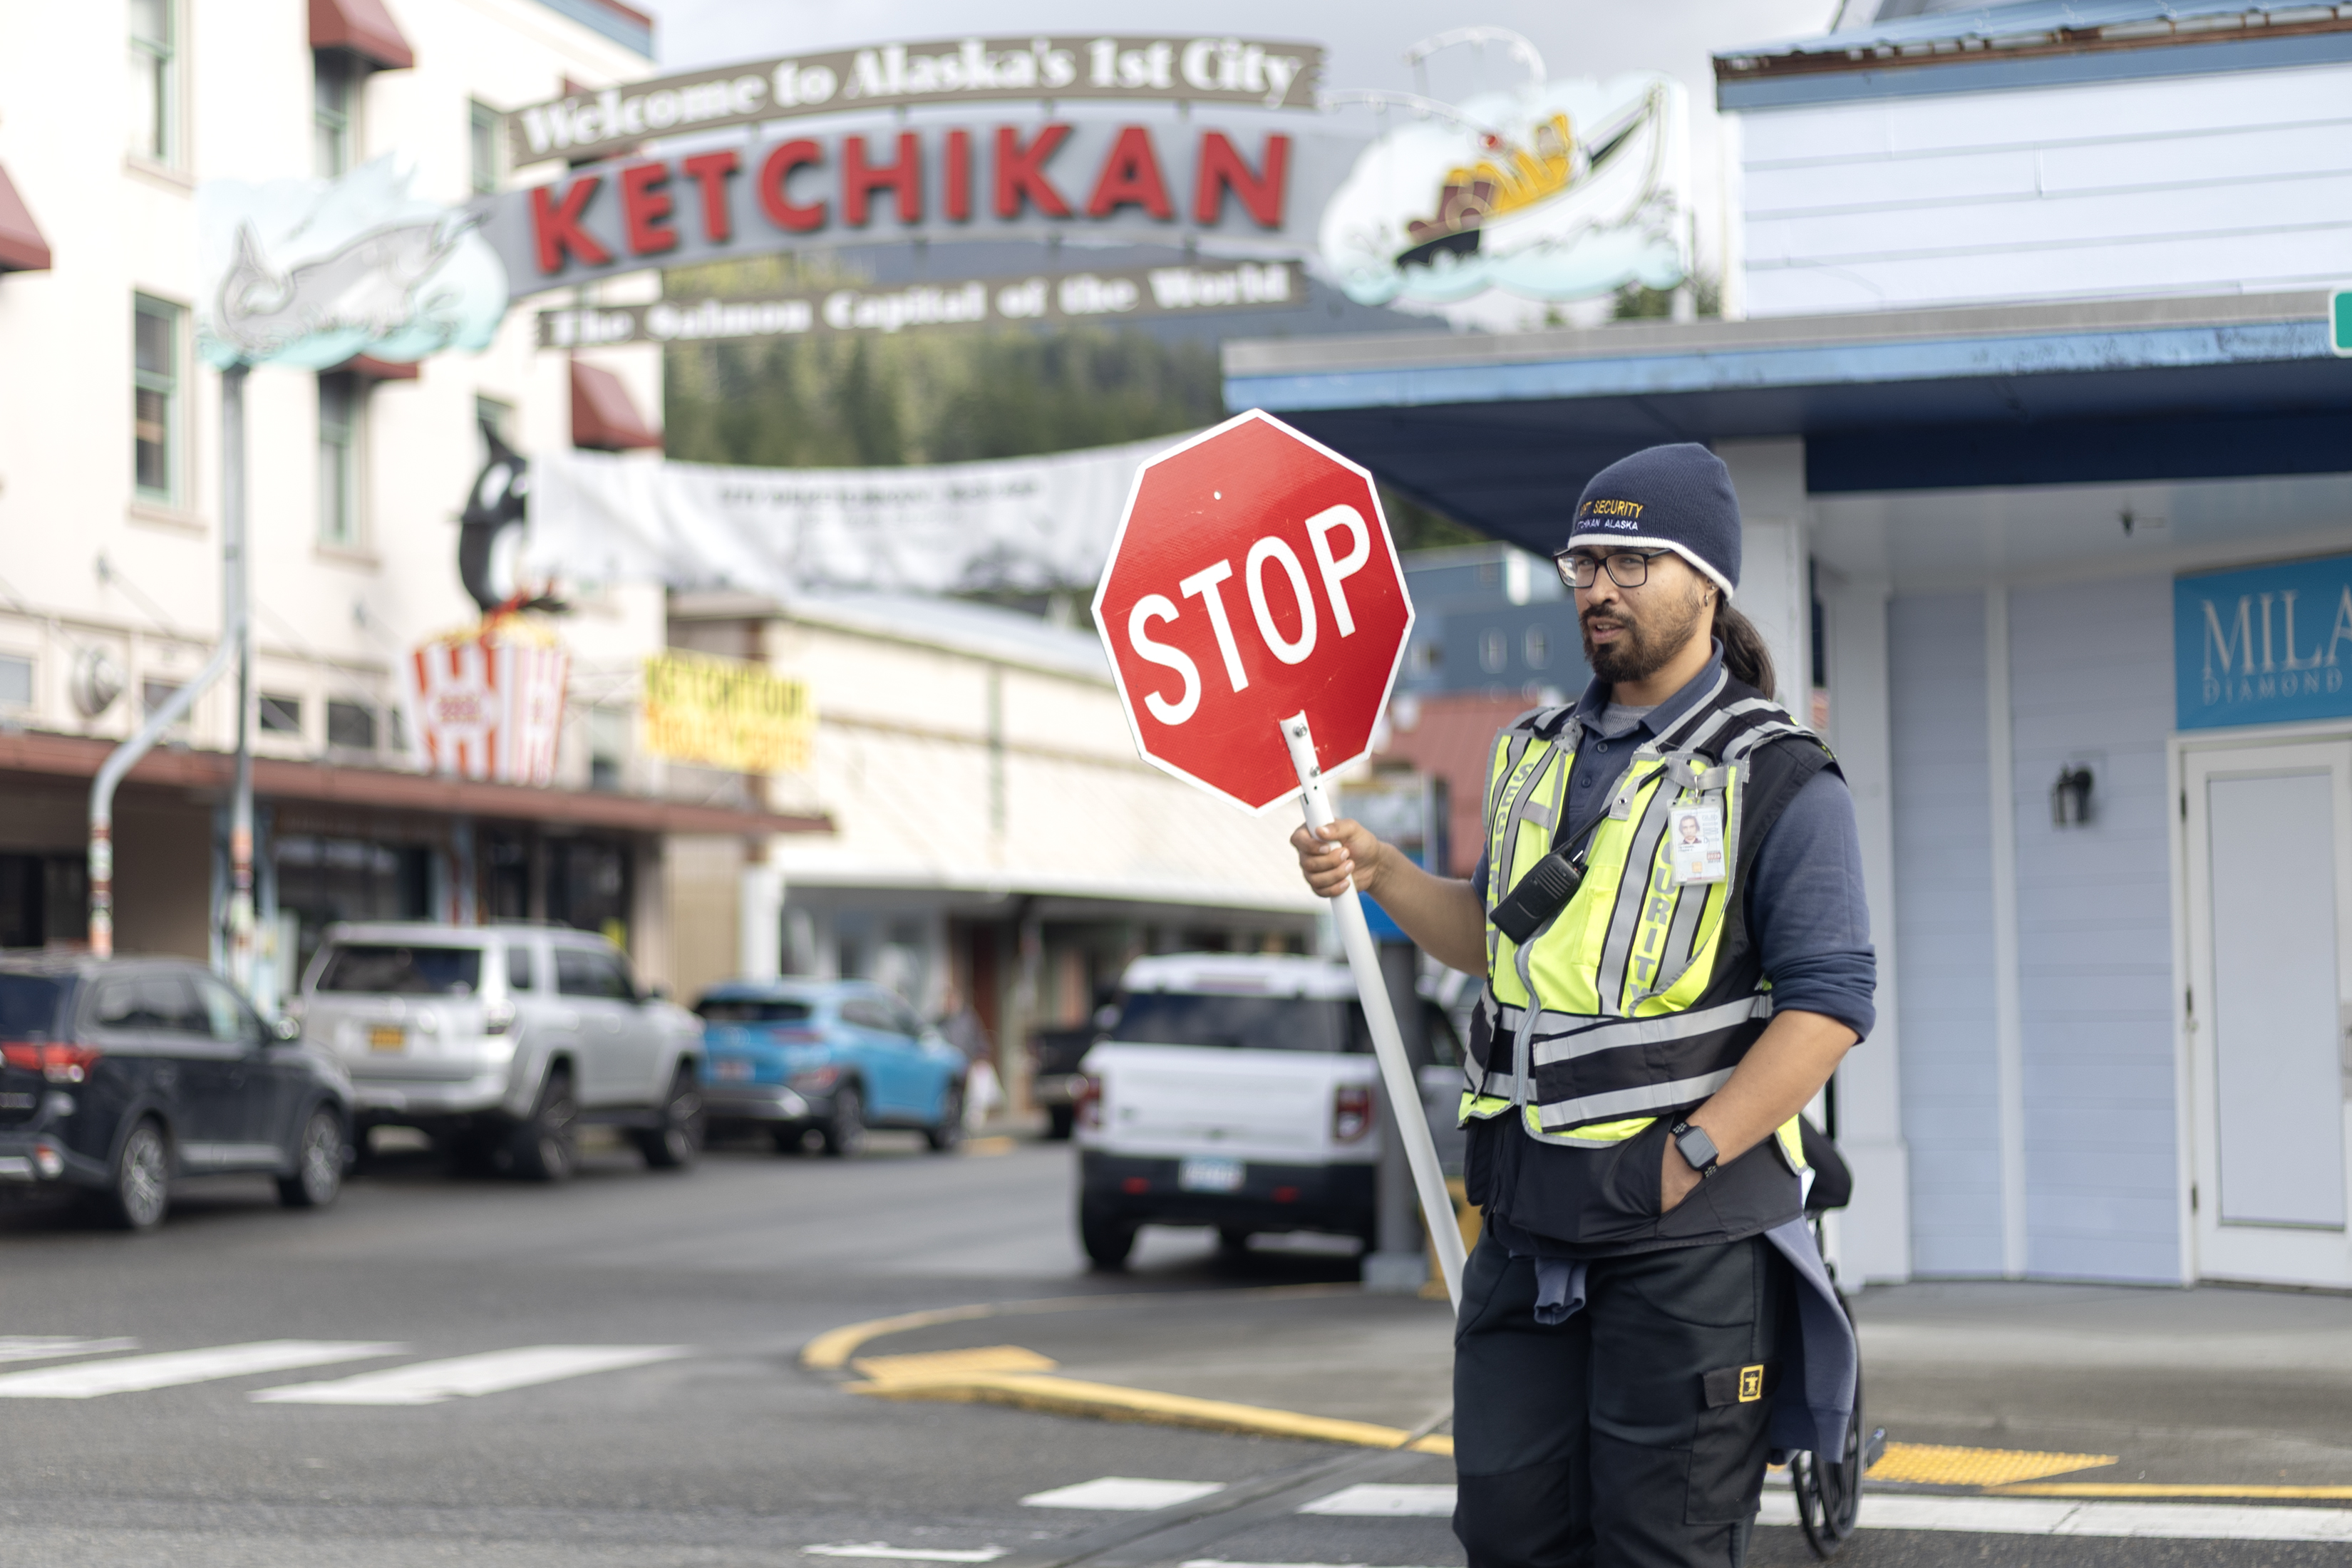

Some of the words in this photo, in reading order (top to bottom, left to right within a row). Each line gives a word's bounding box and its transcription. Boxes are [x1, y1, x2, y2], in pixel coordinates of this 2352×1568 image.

[521, 74, 768, 154] Welcome
[772, 60, 837, 108] to
[841, 37, 1077, 99] Alaska's
[1083, 37, 1177, 89] 1st
[1180, 37, 1304, 110] City
[529, 123, 1291, 275] KETCHIKAN
[551, 309, 636, 344] The
[643, 298, 814, 340] Salmon
[821, 280, 988, 334] Capital
[995, 276, 1050, 319] of
[1058, 272, 1139, 316] the
[1147, 262, 1291, 309] World
[1593, 500, 1644, 519] SECURITY
[1604, 518, 1638, 530] ALASKA
[1128, 504, 1371, 726] STOP
[2202, 667, 2343, 706] DIAMOND
